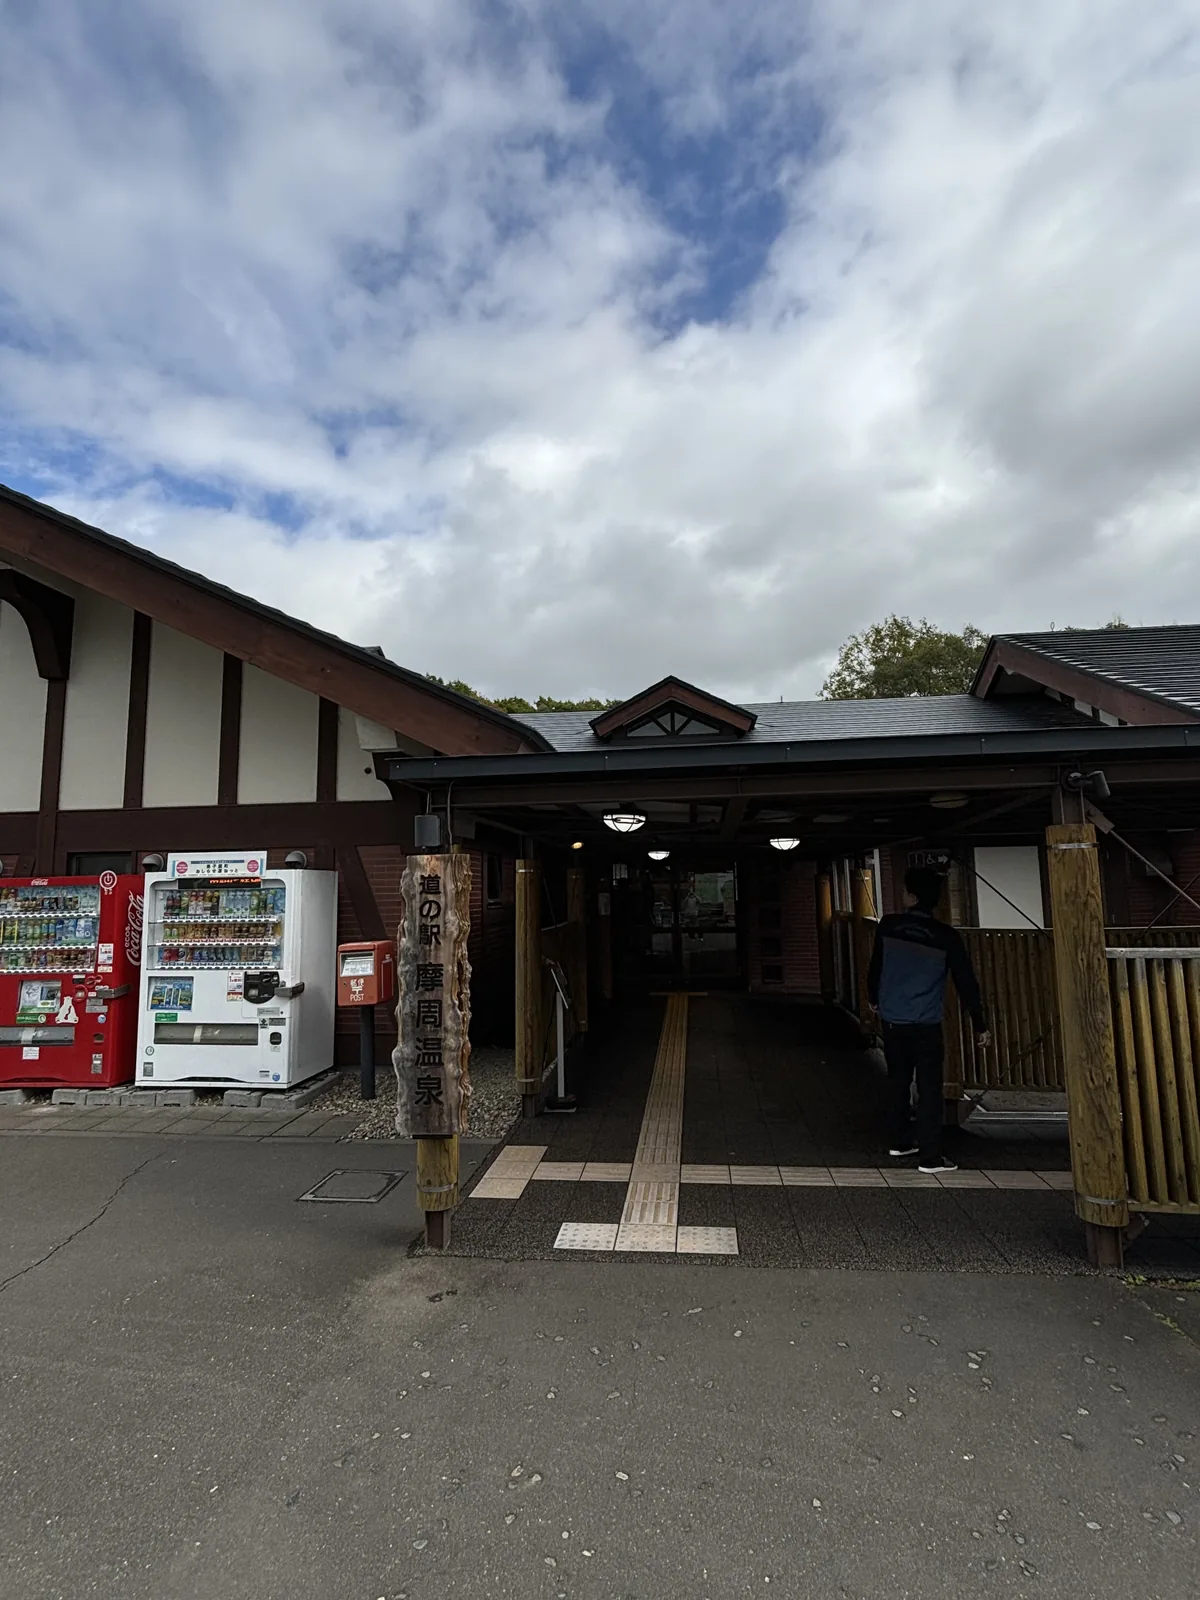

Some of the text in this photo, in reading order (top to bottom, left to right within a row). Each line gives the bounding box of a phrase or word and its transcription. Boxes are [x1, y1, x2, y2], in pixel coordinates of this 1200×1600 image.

[350, 993, 365, 1002] POST
[415, 874, 444, 1106] 道の駅 摩周温泉
